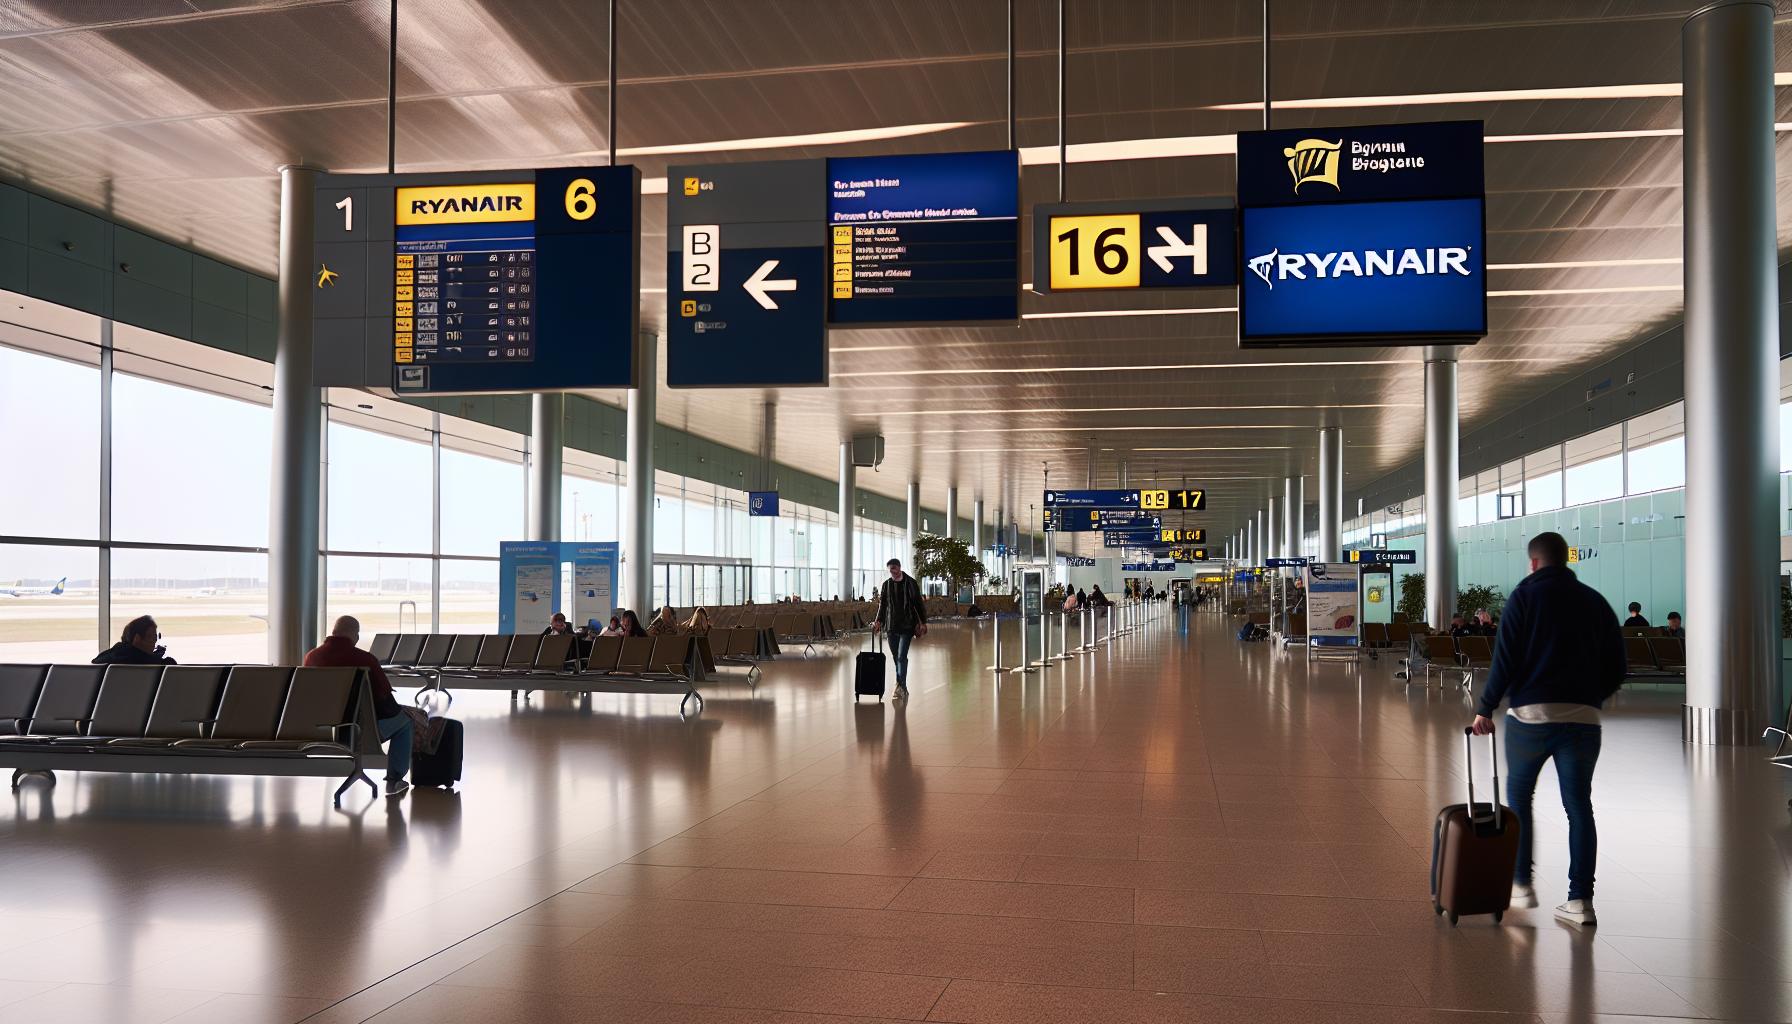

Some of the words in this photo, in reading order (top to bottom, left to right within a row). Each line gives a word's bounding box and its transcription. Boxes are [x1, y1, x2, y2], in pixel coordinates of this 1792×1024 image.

[335, 196, 353, 231] 1
[411, 195, 523, 215] RYANAIR
[565, 178, 597, 221] 6
[691, 232, 712, 256] B
[1058, 227, 1129, 276] 16
[691, 263, 711, 285] 2
[1278, 247, 1472, 281] RYANAIR
[1177, 490, 1202, 508] 17
